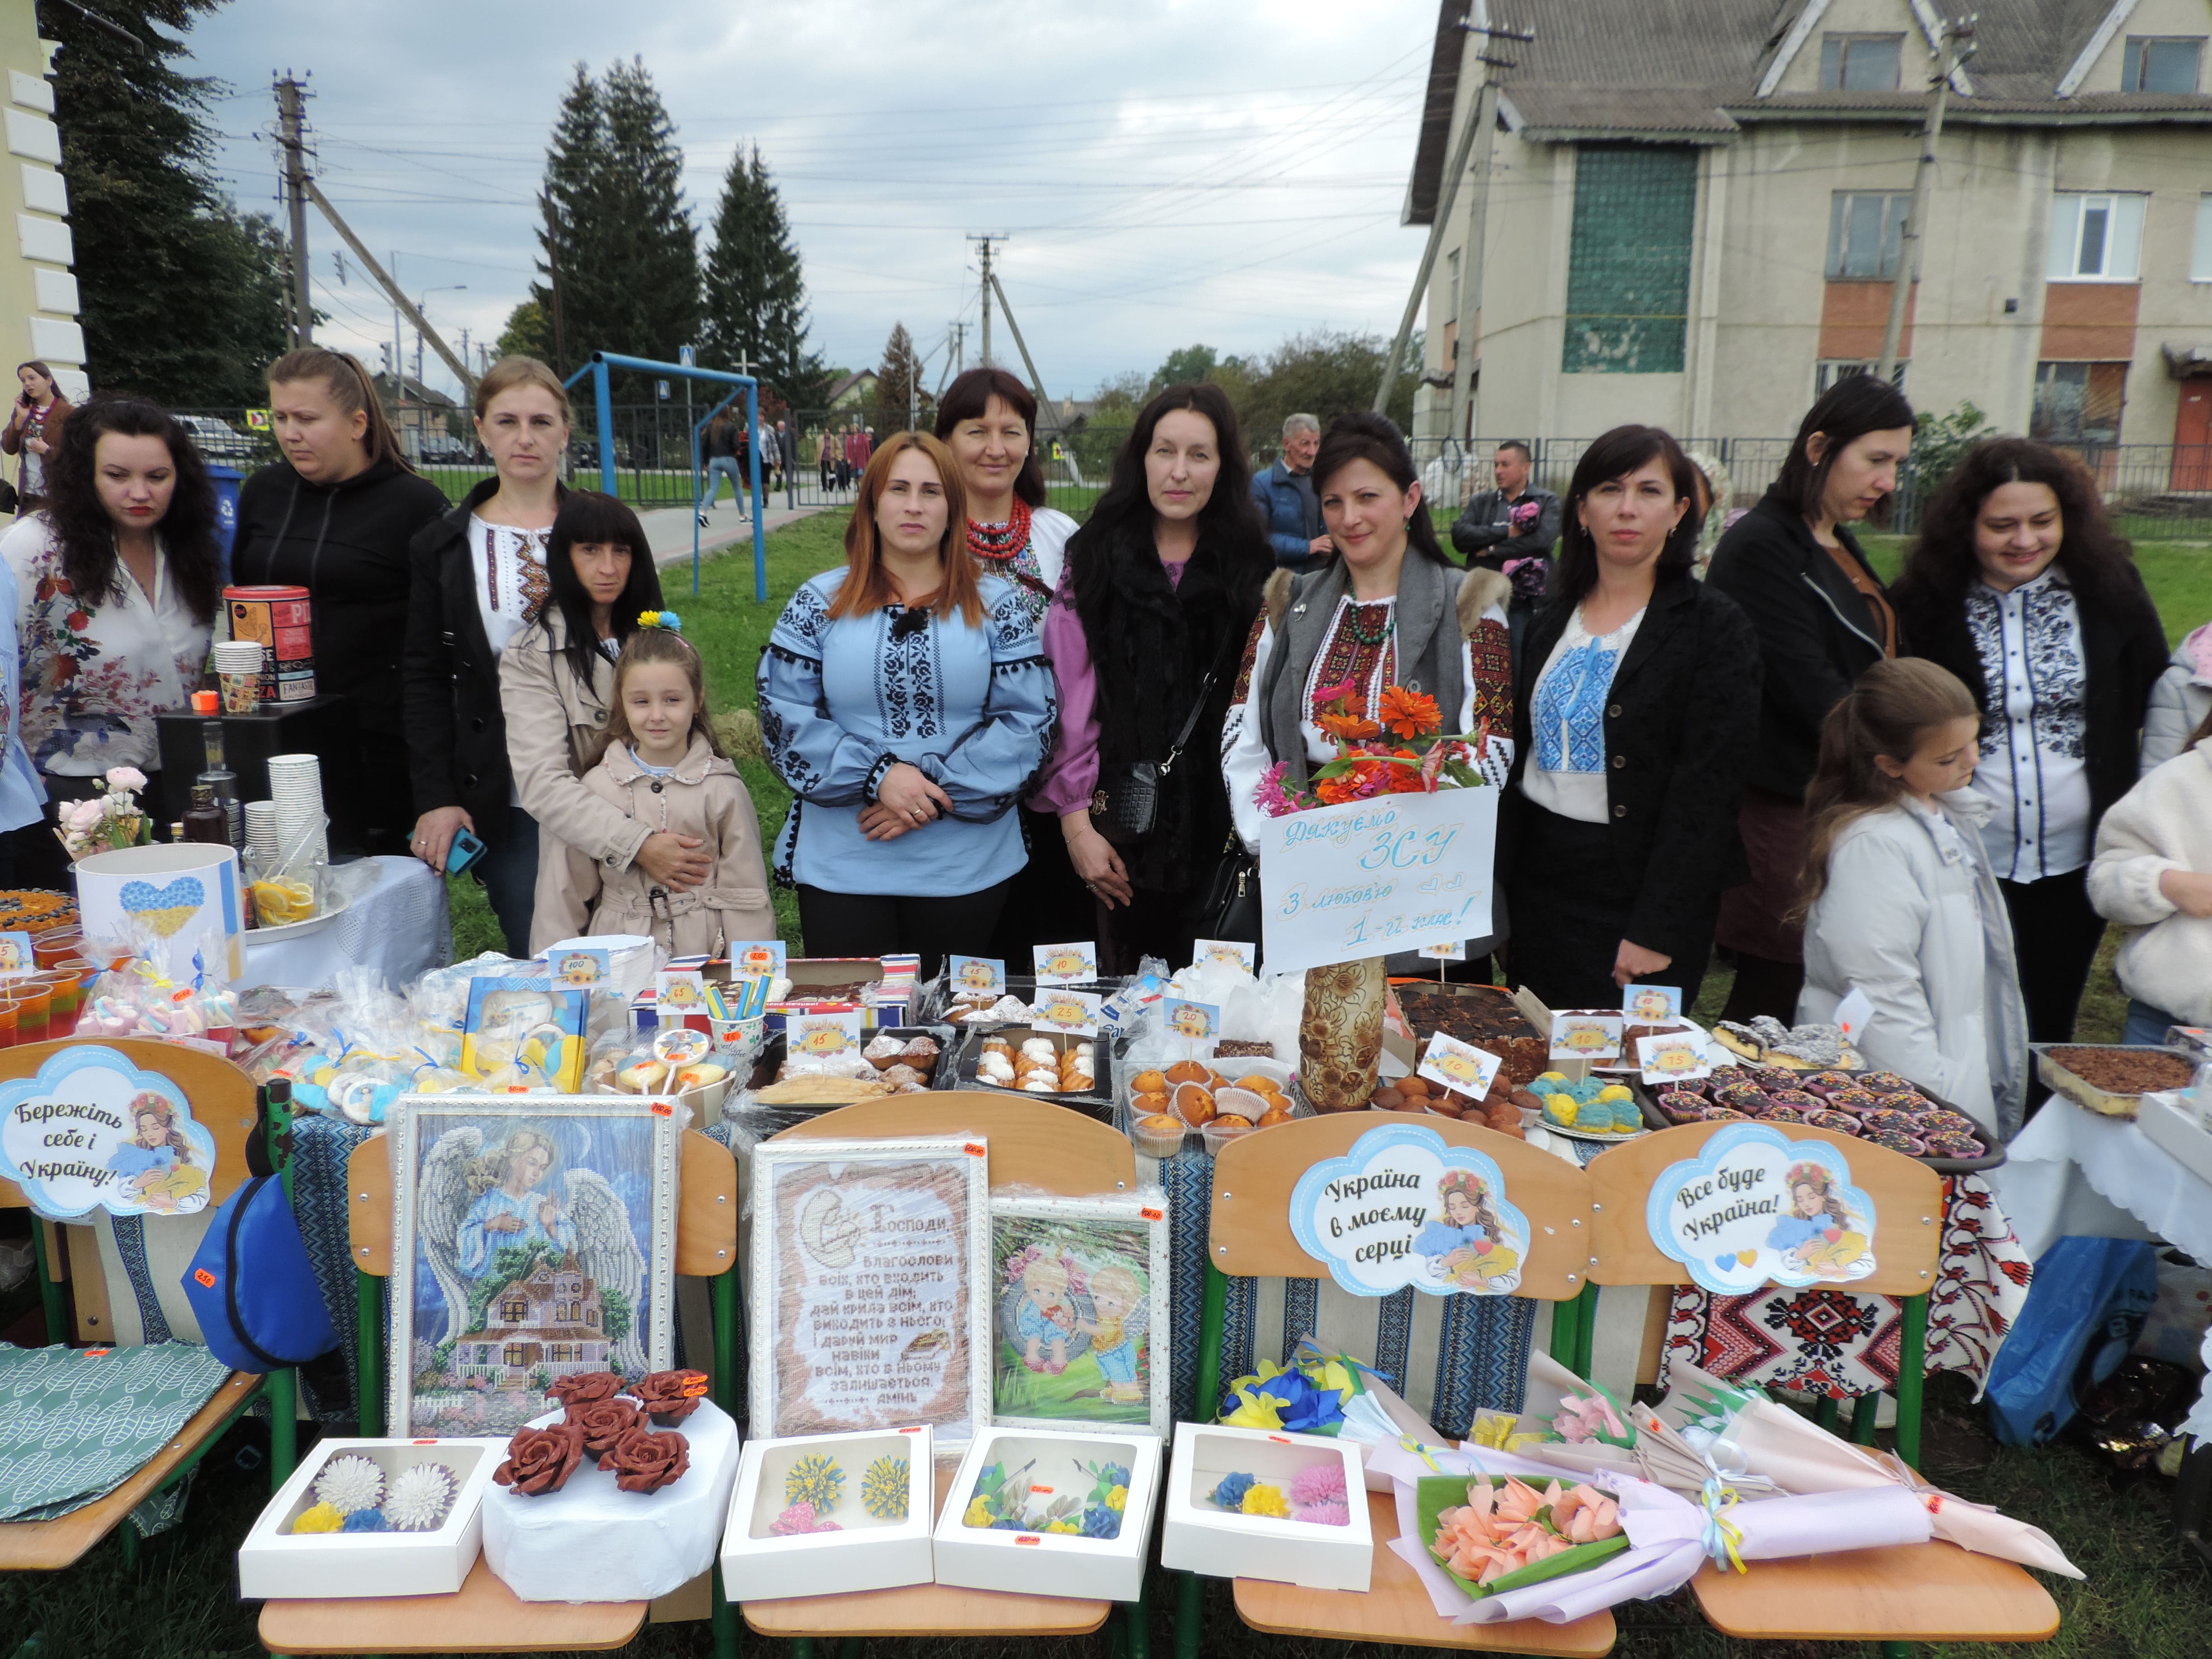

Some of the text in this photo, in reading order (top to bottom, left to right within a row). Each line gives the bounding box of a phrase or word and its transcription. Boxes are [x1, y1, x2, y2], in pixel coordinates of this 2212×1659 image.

[1284, 809, 1397, 847] Дякуємо
[1359, 827, 1459, 871] ЗСУ
[568, 961, 584, 969] 100
[1056, 960, 1067, 970] 10
[674, 988, 684, 998] 65
[1057, 1007, 1072, 1017] 25
[1183, 1012, 1197, 1021] 20
[813, 1033, 828, 1045] 15
[1575, 1034, 1592, 1045] 10
[1446, 1060, 1463, 1070] 10
[14, 1101, 123, 1129] Бережіть
[43, 1129, 97, 1150] себе і
[19, 1159, 118, 1188] Україну!
[1324, 1169, 1421, 1202] Україна
[1677, 1166, 1766, 1209] Все буде
[1330, 1205, 1427, 1238] в моєму
[1683, 1195, 1780, 1241] Україна!
[1355, 1235, 1413, 1264] серці
